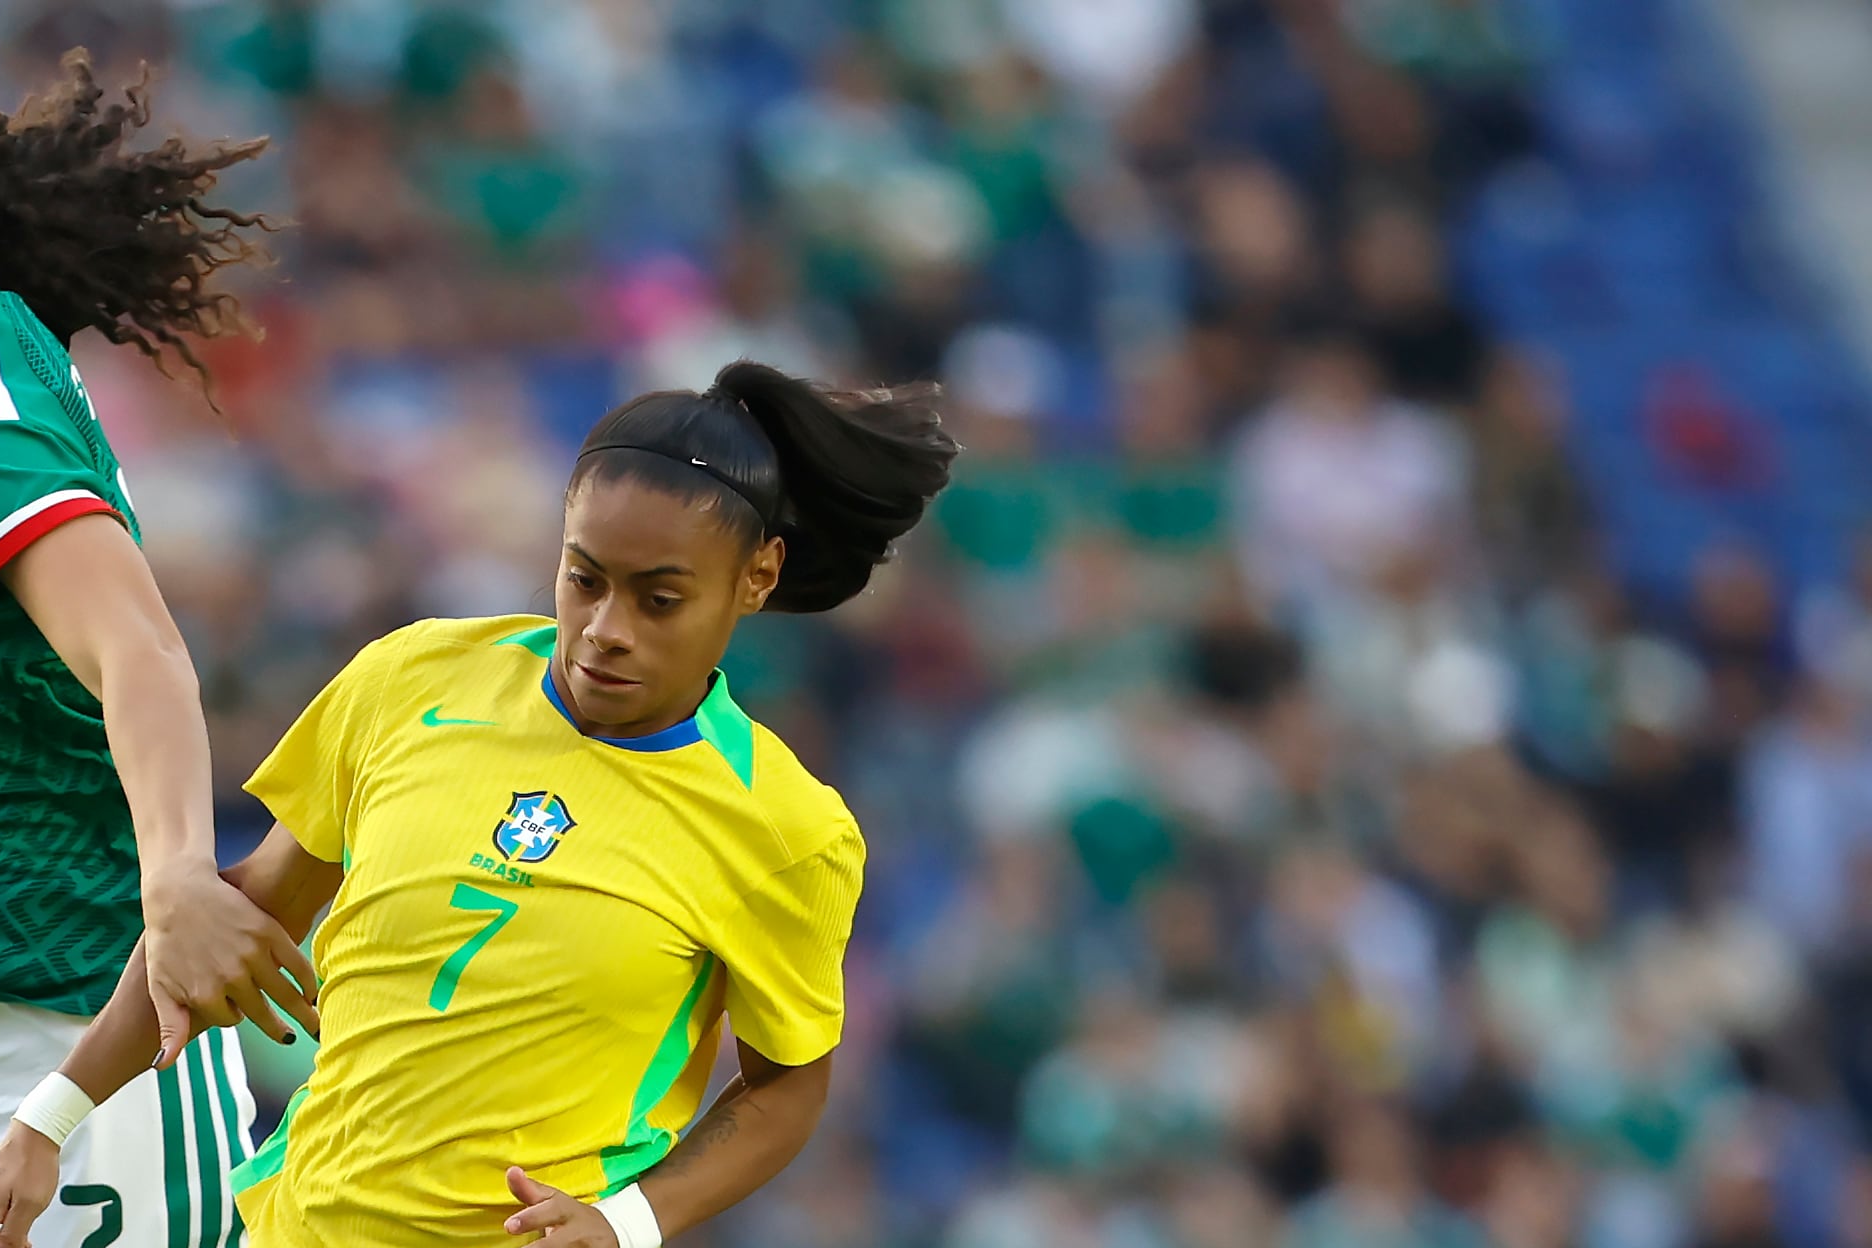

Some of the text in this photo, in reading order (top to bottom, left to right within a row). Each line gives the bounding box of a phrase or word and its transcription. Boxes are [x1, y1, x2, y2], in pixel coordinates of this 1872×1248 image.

[521, 819, 546, 836] CBF
[469, 853, 534, 887] BRASIL
[429, 882, 519, 1012] 7
